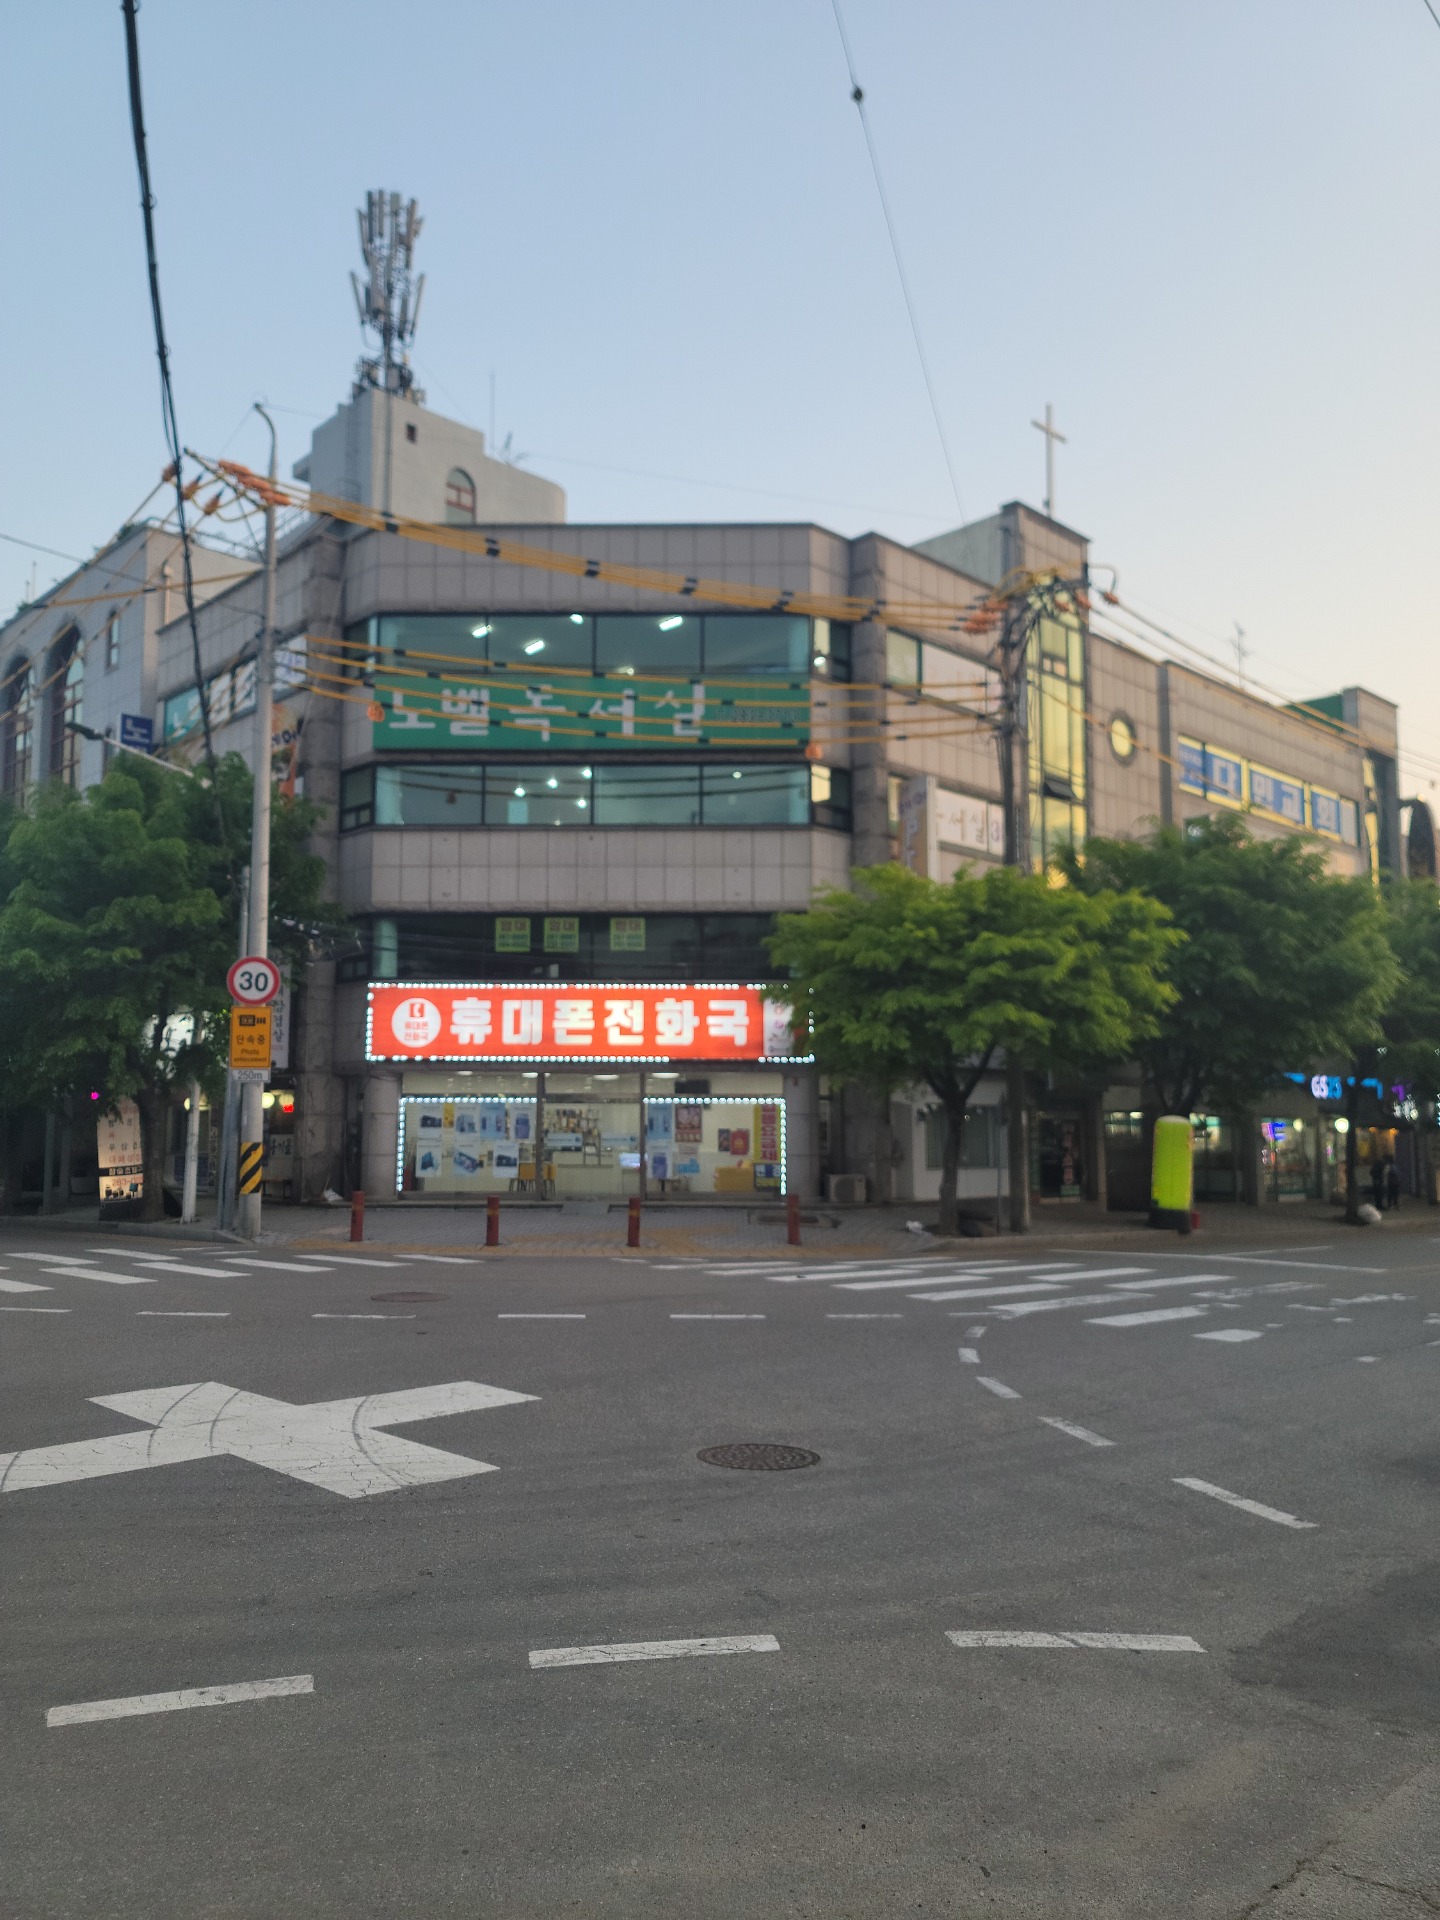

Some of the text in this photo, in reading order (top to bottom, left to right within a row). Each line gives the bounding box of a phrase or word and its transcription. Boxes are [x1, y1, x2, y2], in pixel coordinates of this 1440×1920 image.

[388, 683, 705, 742] 노벨독서실
[239, 971, 268, 992] 30
[450, 997, 750, 1047] 휴대폰전화국
[236, 1034, 265, 1045] 단속중
[238, 1070, 263, 1080] 250m
